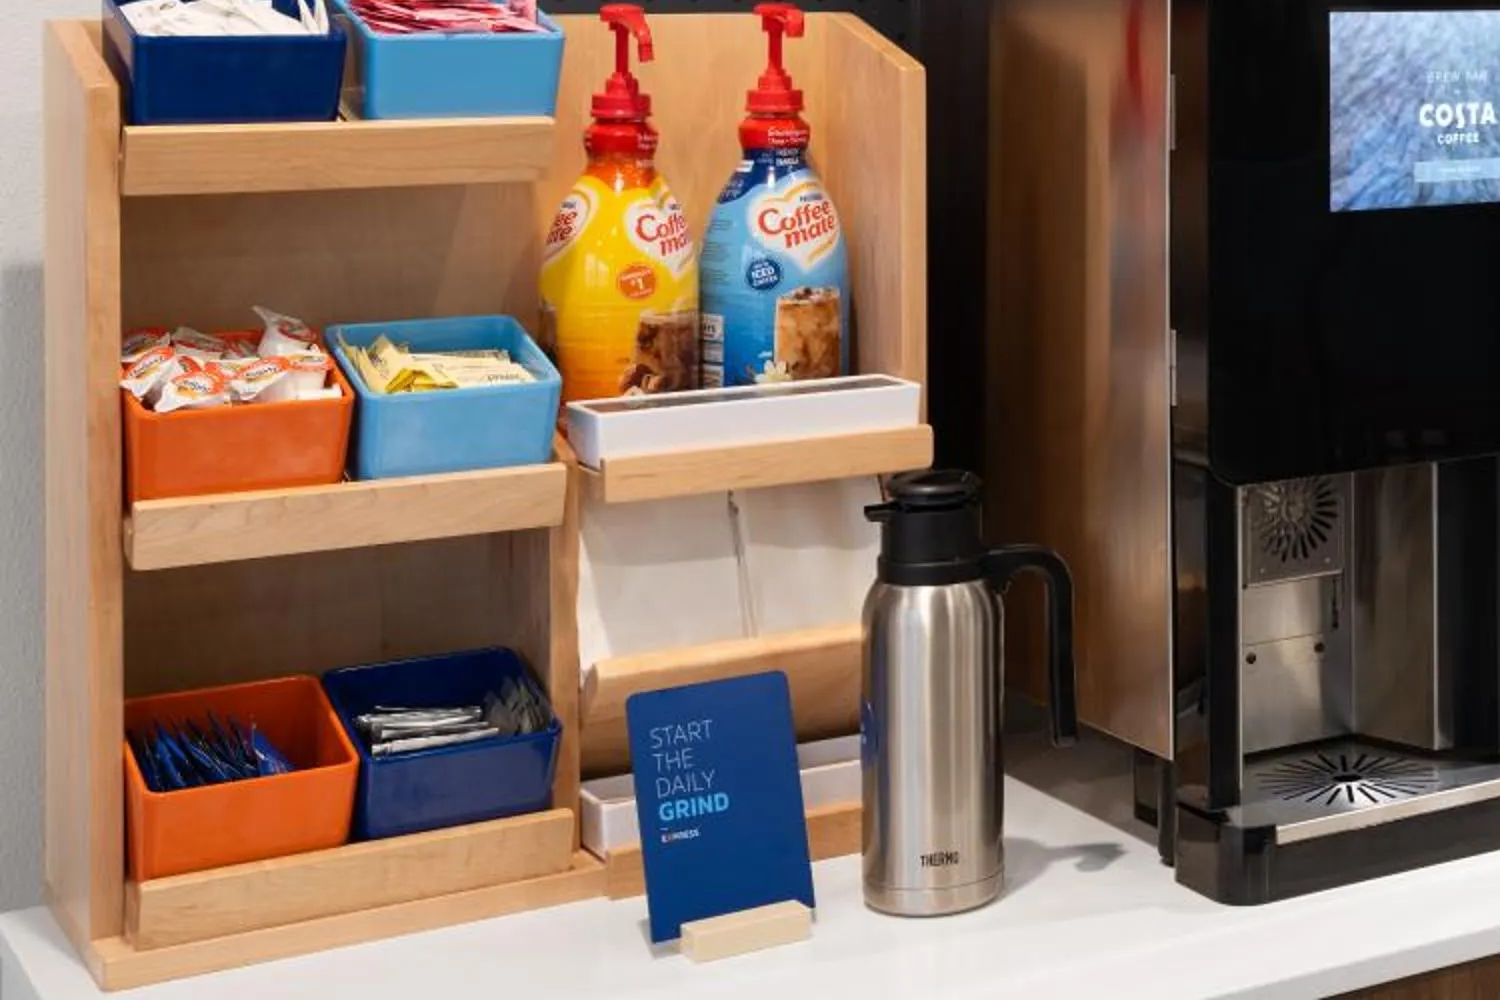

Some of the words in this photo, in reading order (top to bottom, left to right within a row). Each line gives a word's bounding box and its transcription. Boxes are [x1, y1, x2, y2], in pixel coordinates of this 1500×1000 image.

[1418, 101, 1499, 129] COSTA
[1437, 131, 1480, 145] COFFEE
[757, 200, 831, 235] Coffee
[783, 214, 836, 249] mate
[649, 719, 713, 749] START
[651, 747, 695, 773] THE
[655, 769, 715, 799] DAILY
[659, 791, 729, 821] GRIND
